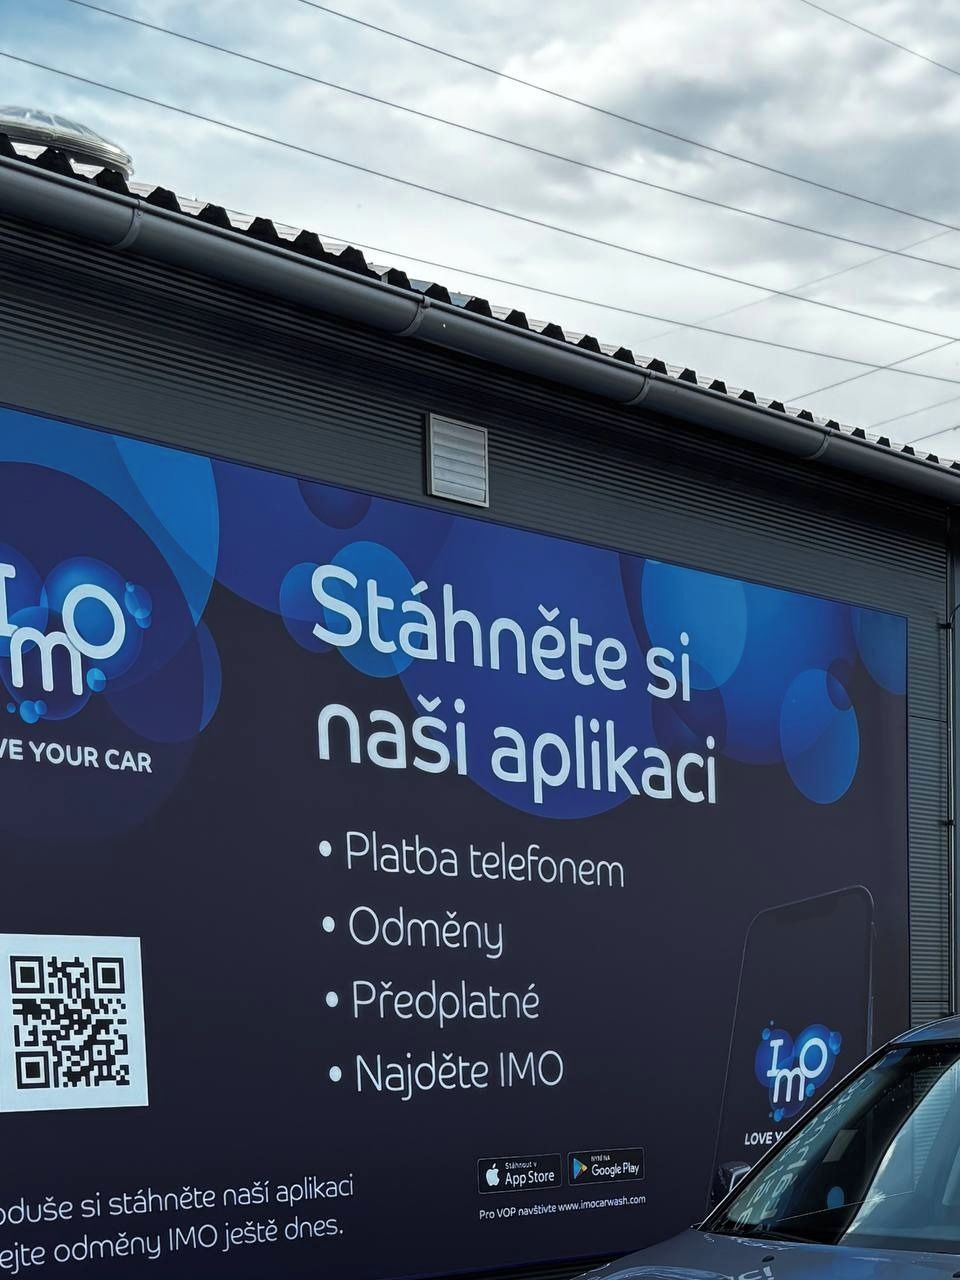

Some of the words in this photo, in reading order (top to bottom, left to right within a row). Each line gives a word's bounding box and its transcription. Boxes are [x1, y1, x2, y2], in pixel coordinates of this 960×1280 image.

[311, 564, 628, 692] Stáhněte
[646, 631, 691, 702] si
[28, 741, 100, 768] YOUR
[104, 749, 153, 774] CAR
[317, 693, 467, 776] naši
[491, 714, 716, 804] aplikaci
[346, 830, 459, 877] Platba
[469, 841, 625, 888] telefonem
[349, 905, 504, 959] Odměny
[352, 979, 540, 1029] Předplatné
[355, 1051, 489, 1102] Najděte
[498, 1049, 565, 1088] IMO
[744, 1132, 773, 1145] LOVE
[504, 1172, 527, 1187] App
[527, 1170, 555, 1184] Store
[591, 1162, 622, 1178] Google
[623, 1161, 641, 1176] Play
[80, 1191, 101, 1218] si
[108, 1186, 216, 1216] stáhněte
[223, 1180, 270, 1207] naší
[276, 1172, 354, 1208] aplikaci
[479, 1208, 495, 1220] Pro
[497, 1205, 517, 1218] VOP
[557, 1195, 647, 1212] www.imocarwash.com
[53, 1233, 161, 1262] odměny
[169, 1224, 218, 1252] IMO
[222, 1219, 278, 1253] ještě
[284, 1215, 344, 1241] dnes.
